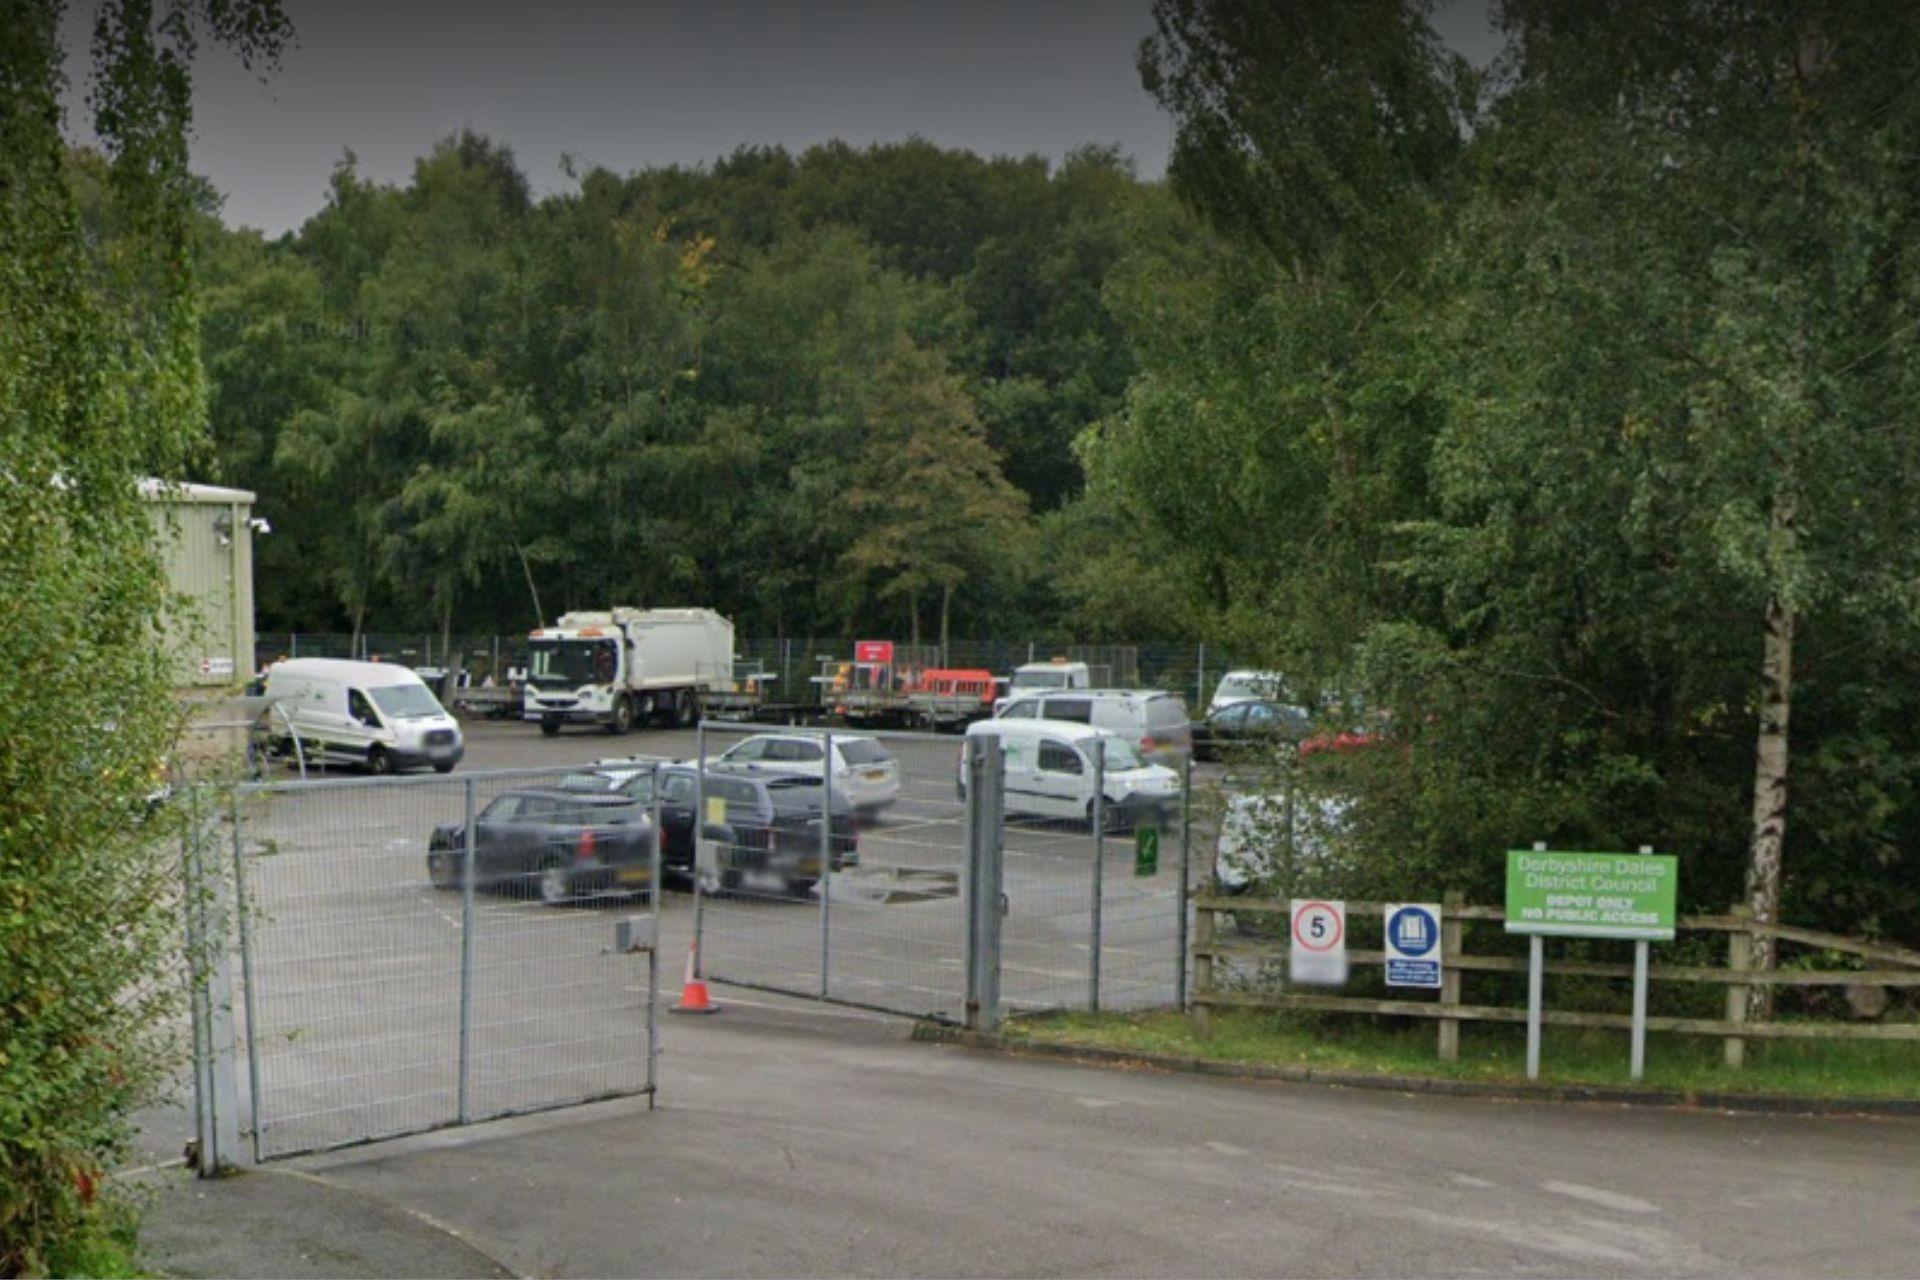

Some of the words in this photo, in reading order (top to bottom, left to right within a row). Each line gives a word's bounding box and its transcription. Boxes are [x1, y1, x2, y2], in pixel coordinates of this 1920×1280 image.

[1518, 855, 1610, 874] Derbyshire
[1616, 859, 1666, 877] Dales
[1525, 873, 1585, 890] District
[1592, 875, 1656, 892] Council
[1546, 894, 1593, 907] DEPOT
[1546, 908, 1598, 921] PUBLIC
[1310, 916, 1325, 938] 5
